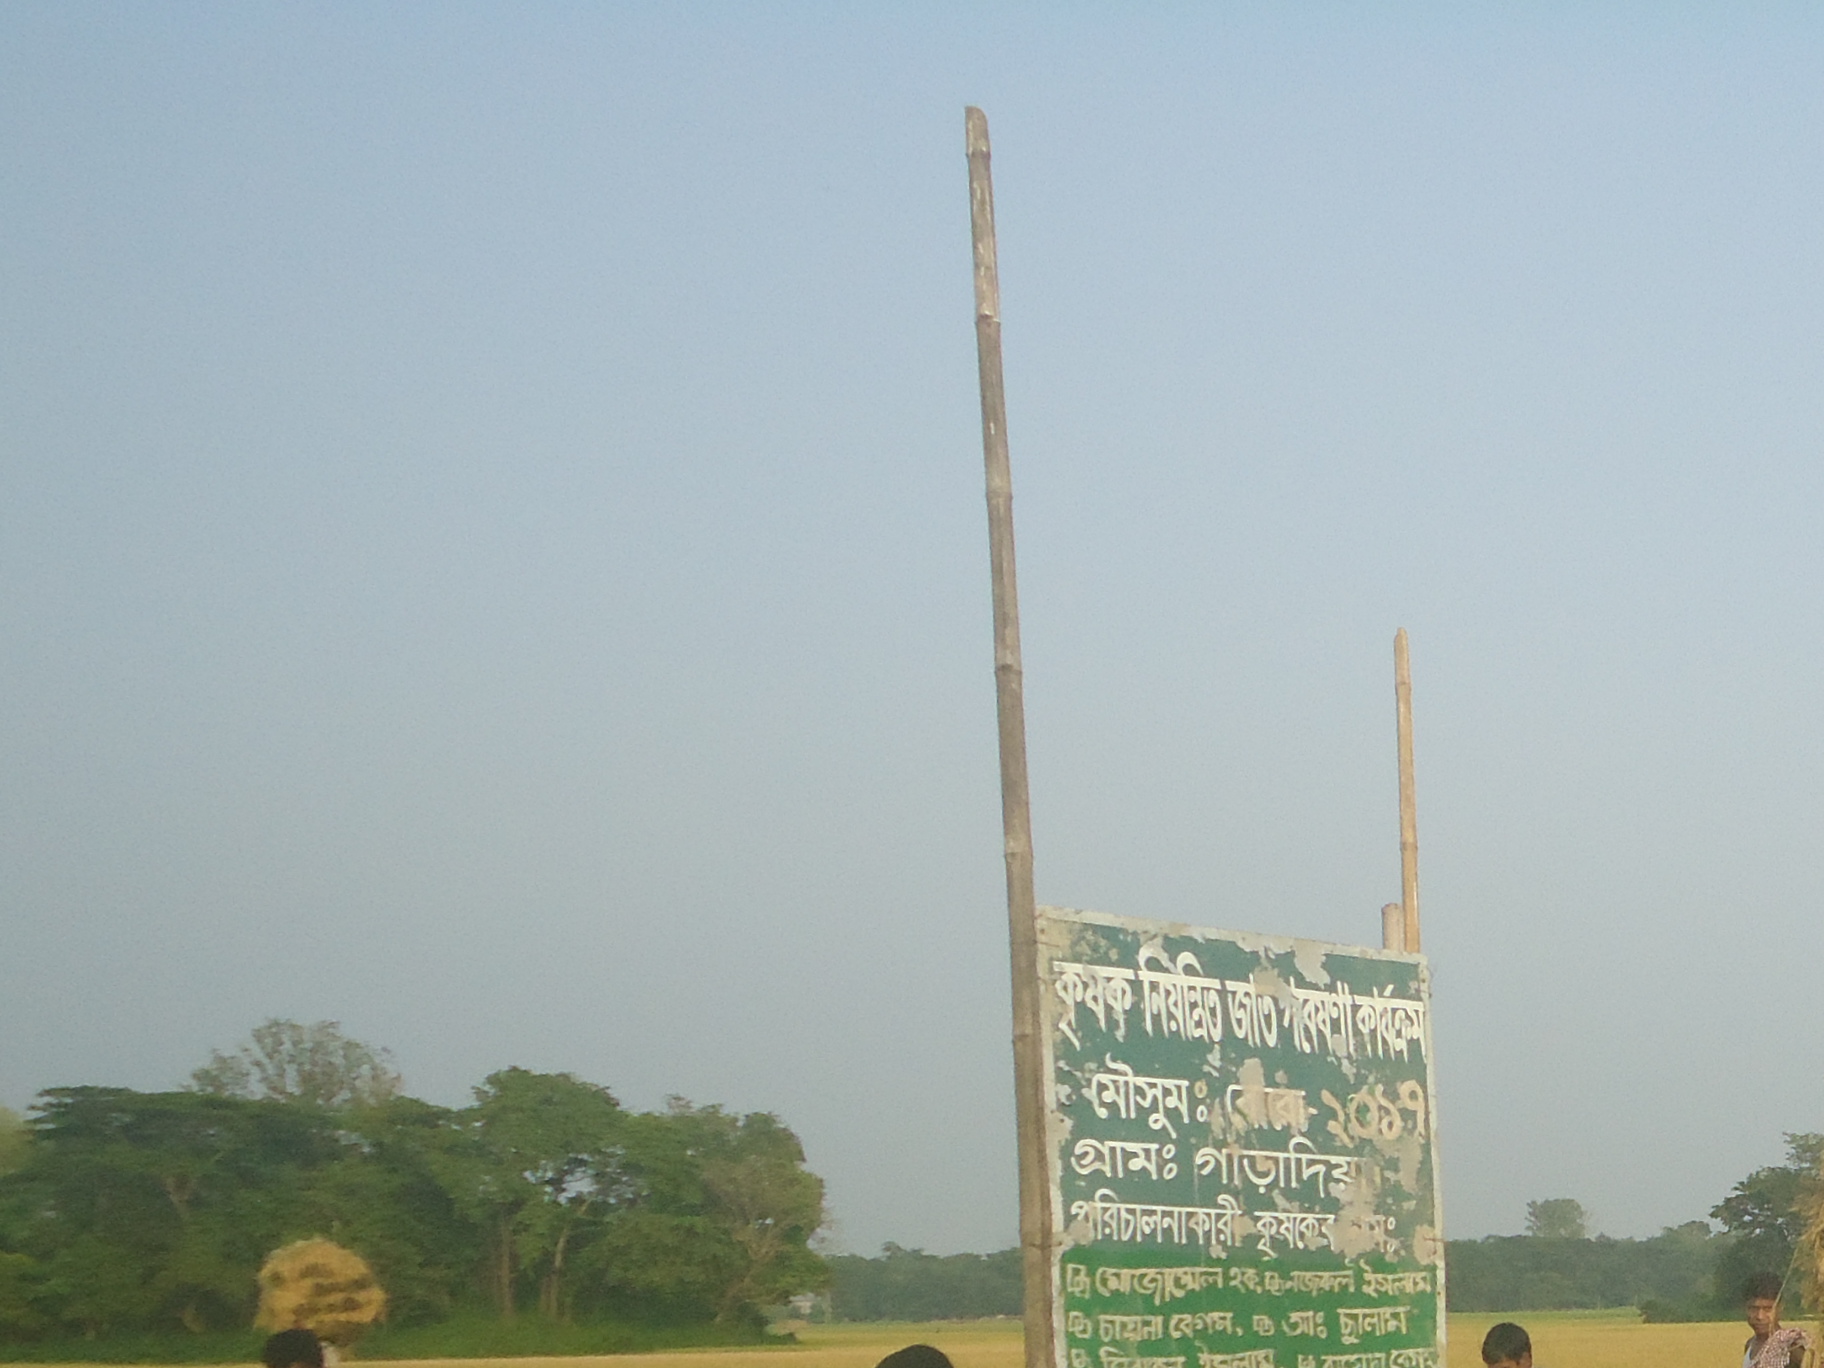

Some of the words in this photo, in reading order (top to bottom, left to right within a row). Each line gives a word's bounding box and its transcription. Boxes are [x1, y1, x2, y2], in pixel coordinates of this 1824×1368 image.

[1053, 961, 1135, 1051] কৃষক
[1225, 973, 1278, 1048] জাত
[1071, 1188, 1242, 1246] পরিচালনাকারী
[1096, 1267, 1223, 1306] মোজাম্মেল
[1362, 1259, 1431, 1298] ইসলাম
